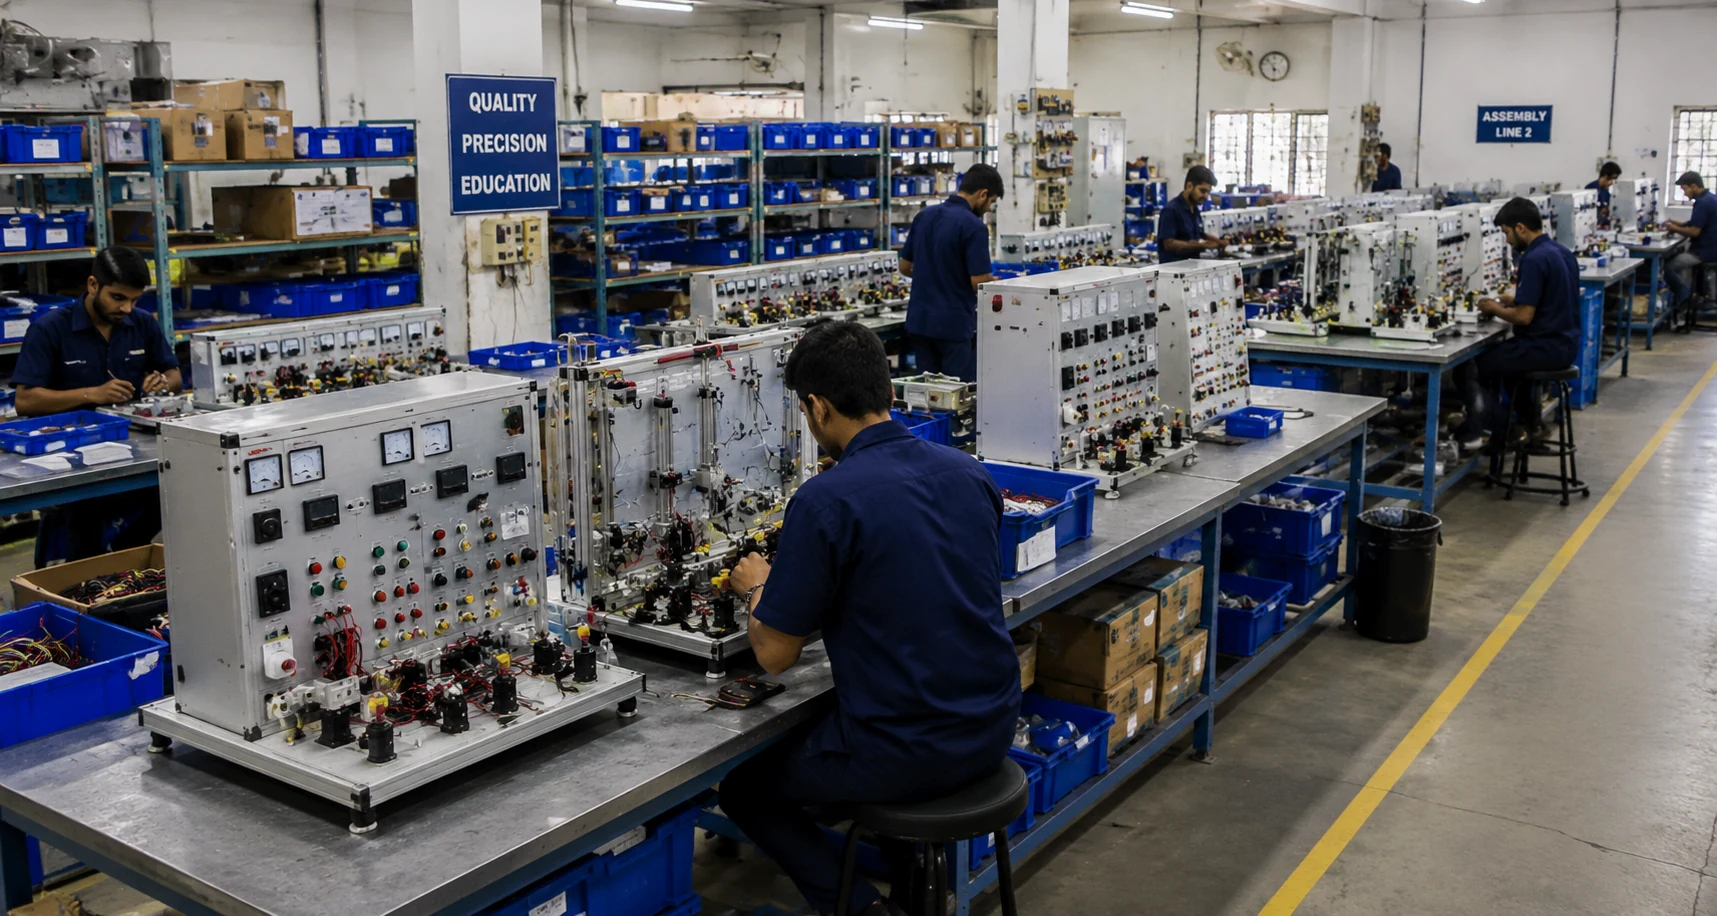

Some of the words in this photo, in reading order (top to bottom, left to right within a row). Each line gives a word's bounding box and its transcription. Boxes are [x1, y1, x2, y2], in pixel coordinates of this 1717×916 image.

[469, 92, 537, 114] QUALITY
[1482, 111, 1547, 122] ASSEMBLY
[1495, 127, 1522, 138] LINE
[1525, 127, 1532, 138] 2
[462, 133, 547, 154] PRECISION
[461, 173, 551, 195] EDUCATION
